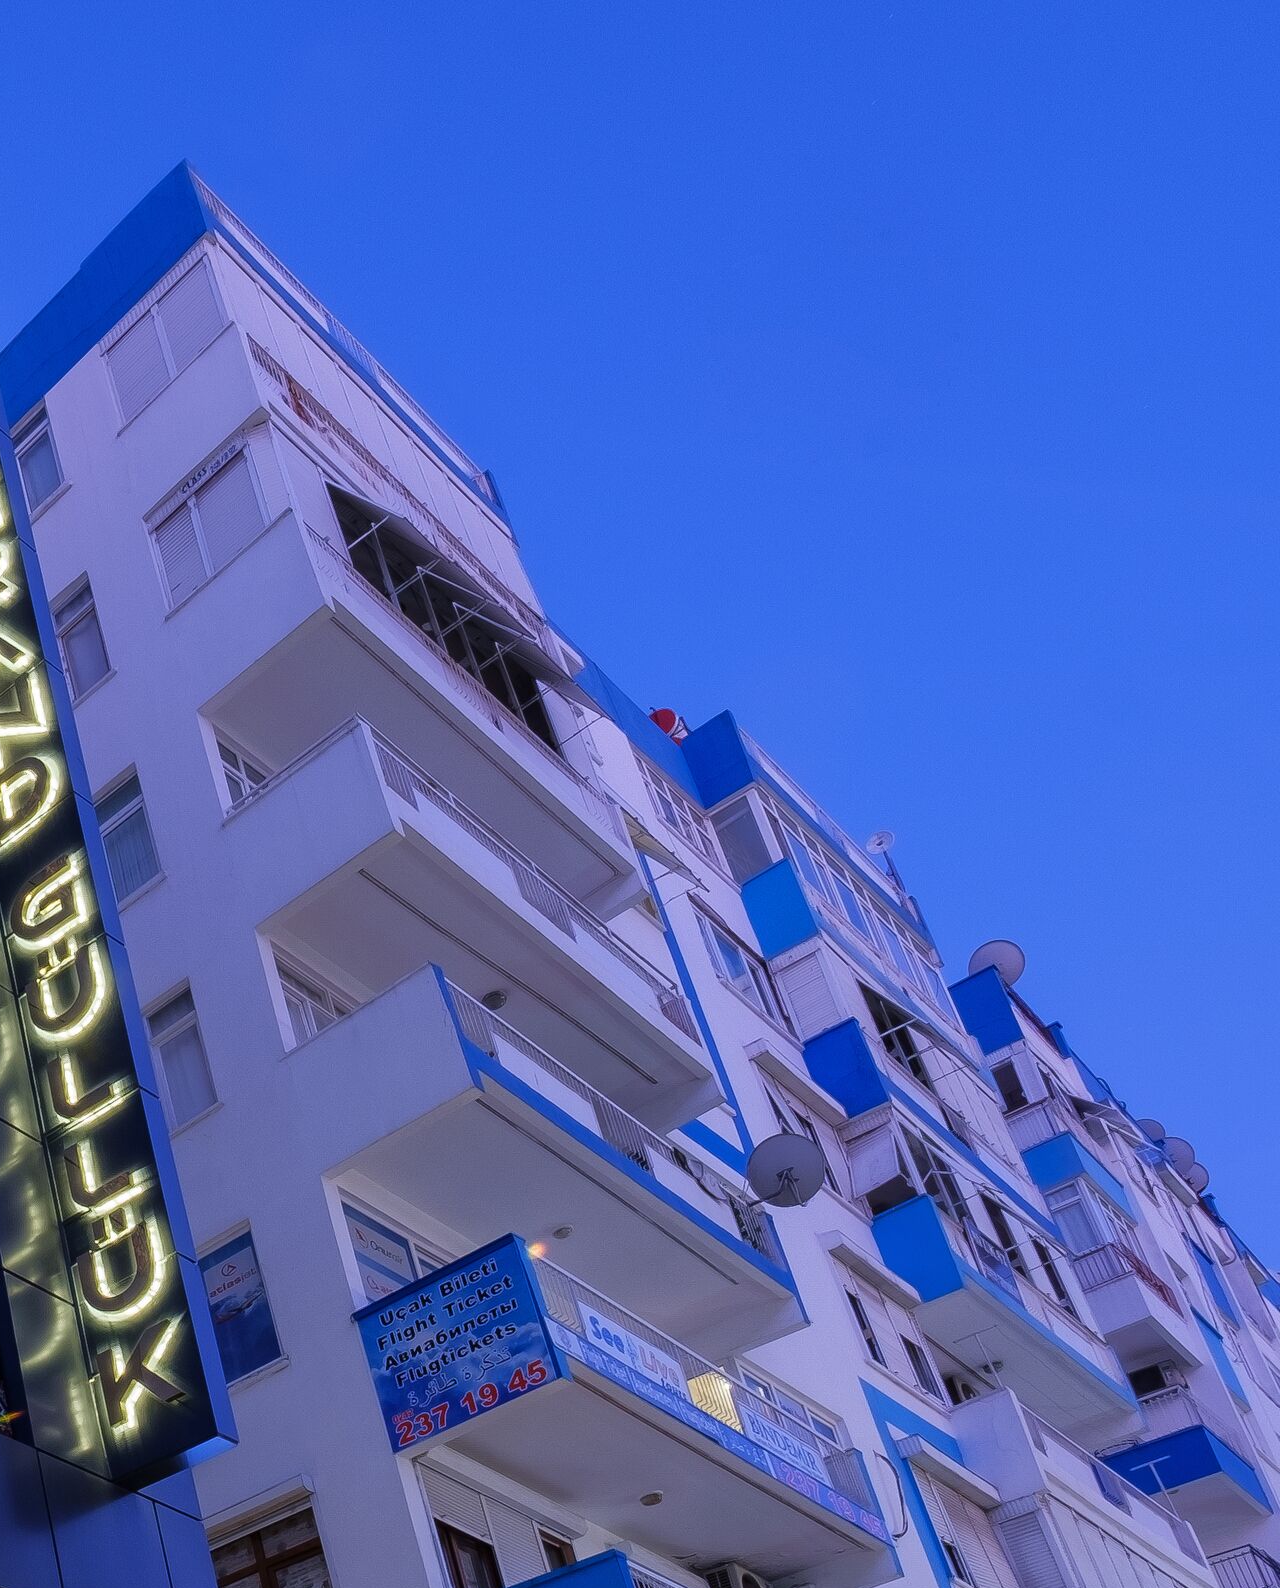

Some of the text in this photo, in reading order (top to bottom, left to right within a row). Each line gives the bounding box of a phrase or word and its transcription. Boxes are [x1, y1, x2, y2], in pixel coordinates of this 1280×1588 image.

[12, 850, 188, 1432] GÜLLÜK
[377, 1275, 513, 1351] Flight Ticket
[378, 1258, 497, 1327] Uçak Bileti
[385, 1299, 518, 1370] Авиабилеты
[396, 1323, 517, 1389] Flugtickets
[589, 1315, 625, 1354] See
[396, 1402, 449, 1447] 237
[461, 1383, 499, 1415] 19
[508, 1360, 548, 1394] 45
